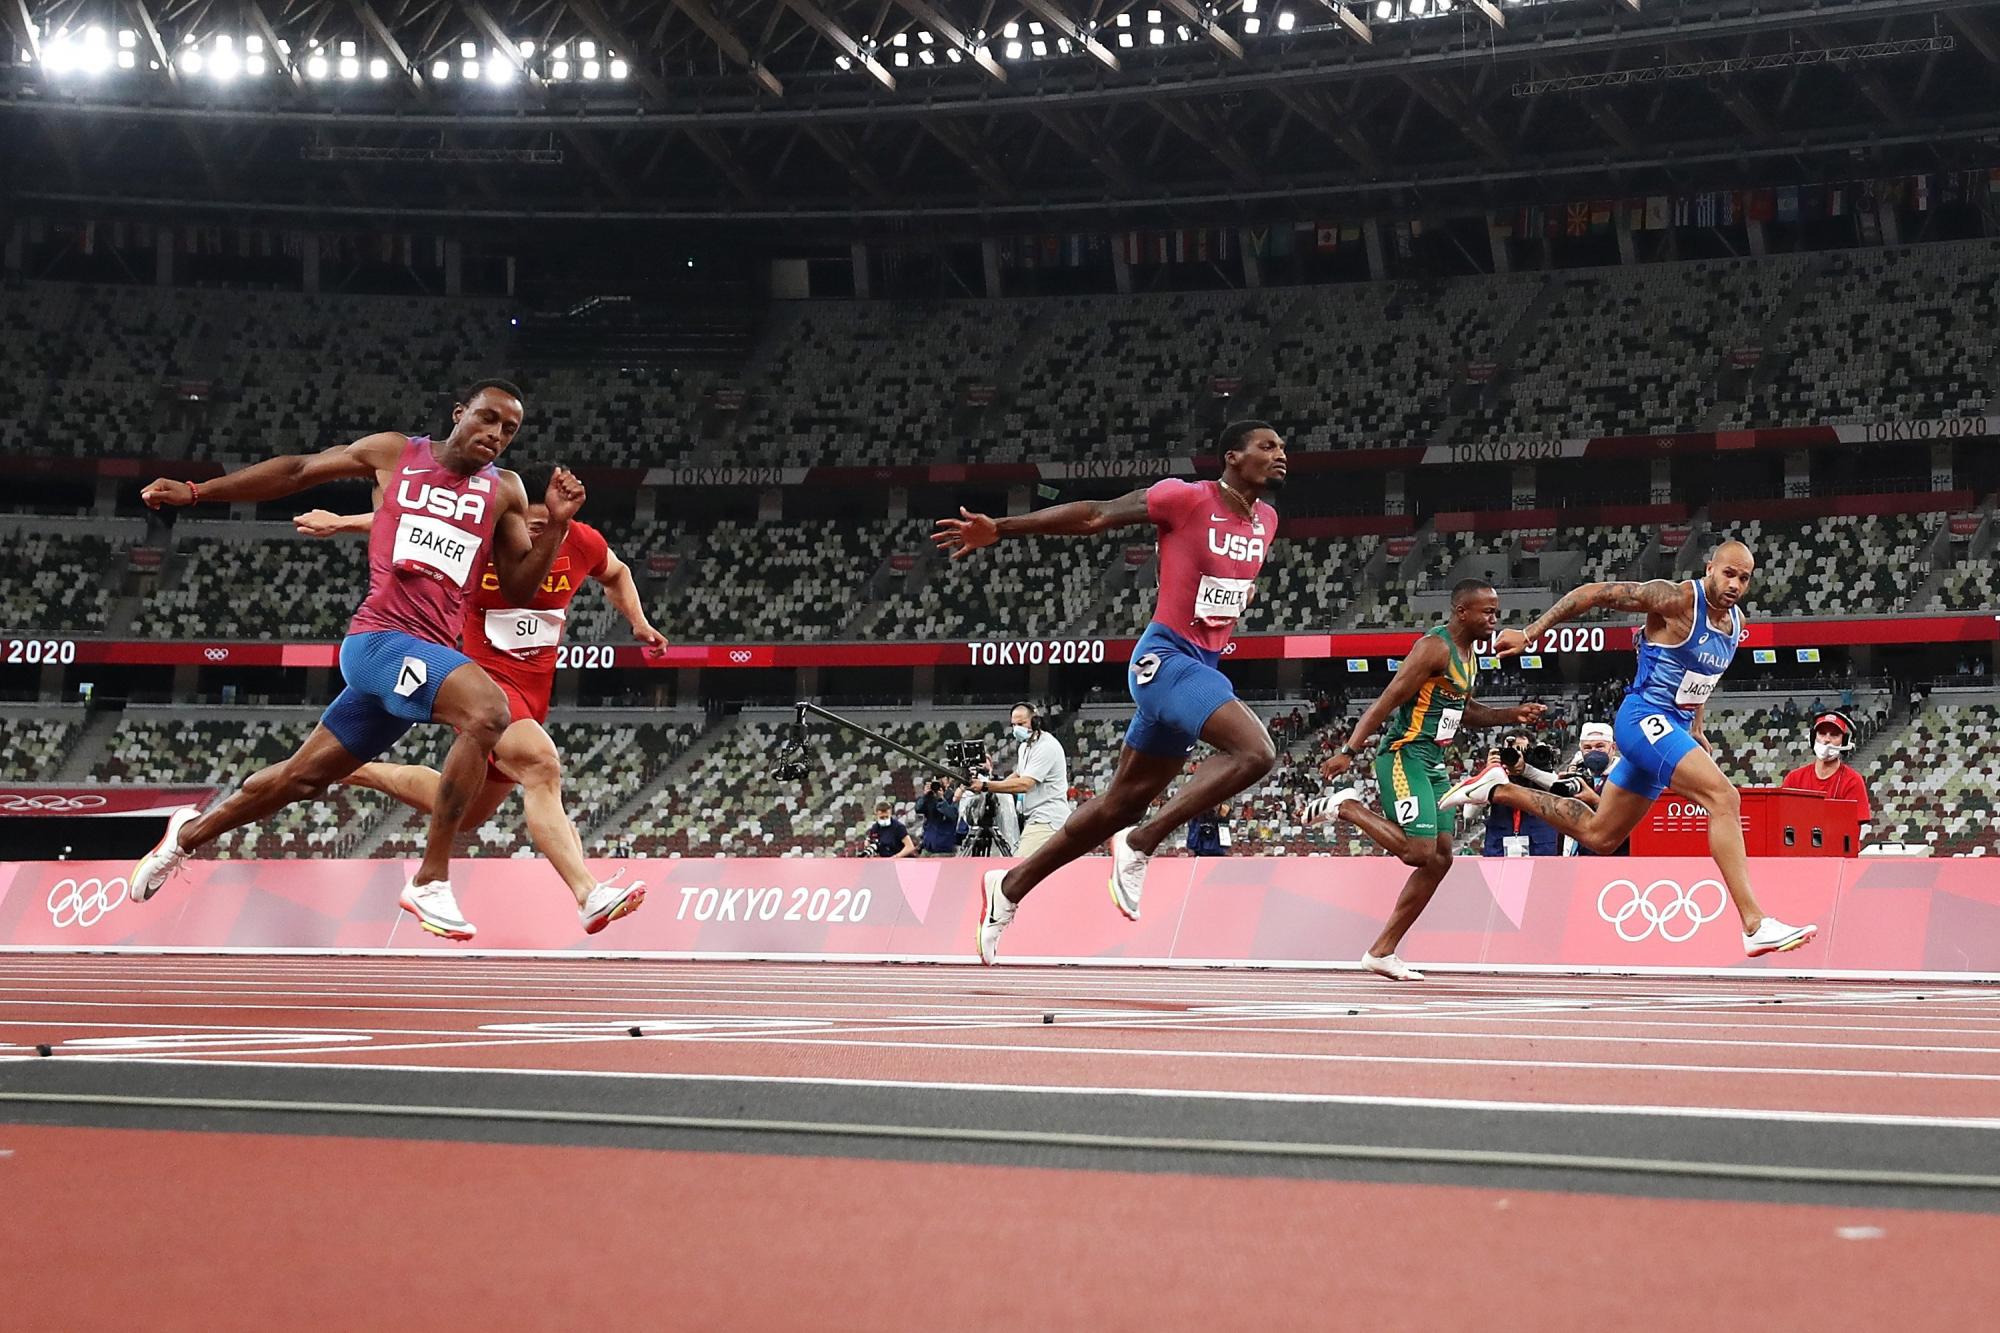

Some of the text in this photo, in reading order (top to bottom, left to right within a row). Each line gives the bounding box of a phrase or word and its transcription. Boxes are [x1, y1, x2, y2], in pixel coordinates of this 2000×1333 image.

[1862, 417, 1986, 442] TOKYO 2020
[1447, 440, 1562, 463] TOKYO 2020
[672, 468, 782, 486] TOKYO 2020
[1062, 459, 1171, 479] TOKYO 2020
[397, 480, 485, 524] USA
[409, 527, 465, 562] BAKER
[1208, 528, 1264, 562] USA
[481, 573, 571, 592] CNA
[516, 620, 538, 636] SU
[1544, 628, 1604, 652] 2020
[8, 640, 75, 663] 2020
[556, 646, 614, 668] 2020
[968, 640, 1104, 665] TOKYO 2020
[1698, 652, 1729, 668] ITALIA
[401, 665, 422, 686] 7
[1647, 717, 1665, 736] 3
[1400, 801, 1413, 821] 2
[677, 887, 872, 922] TOKYO 2020
